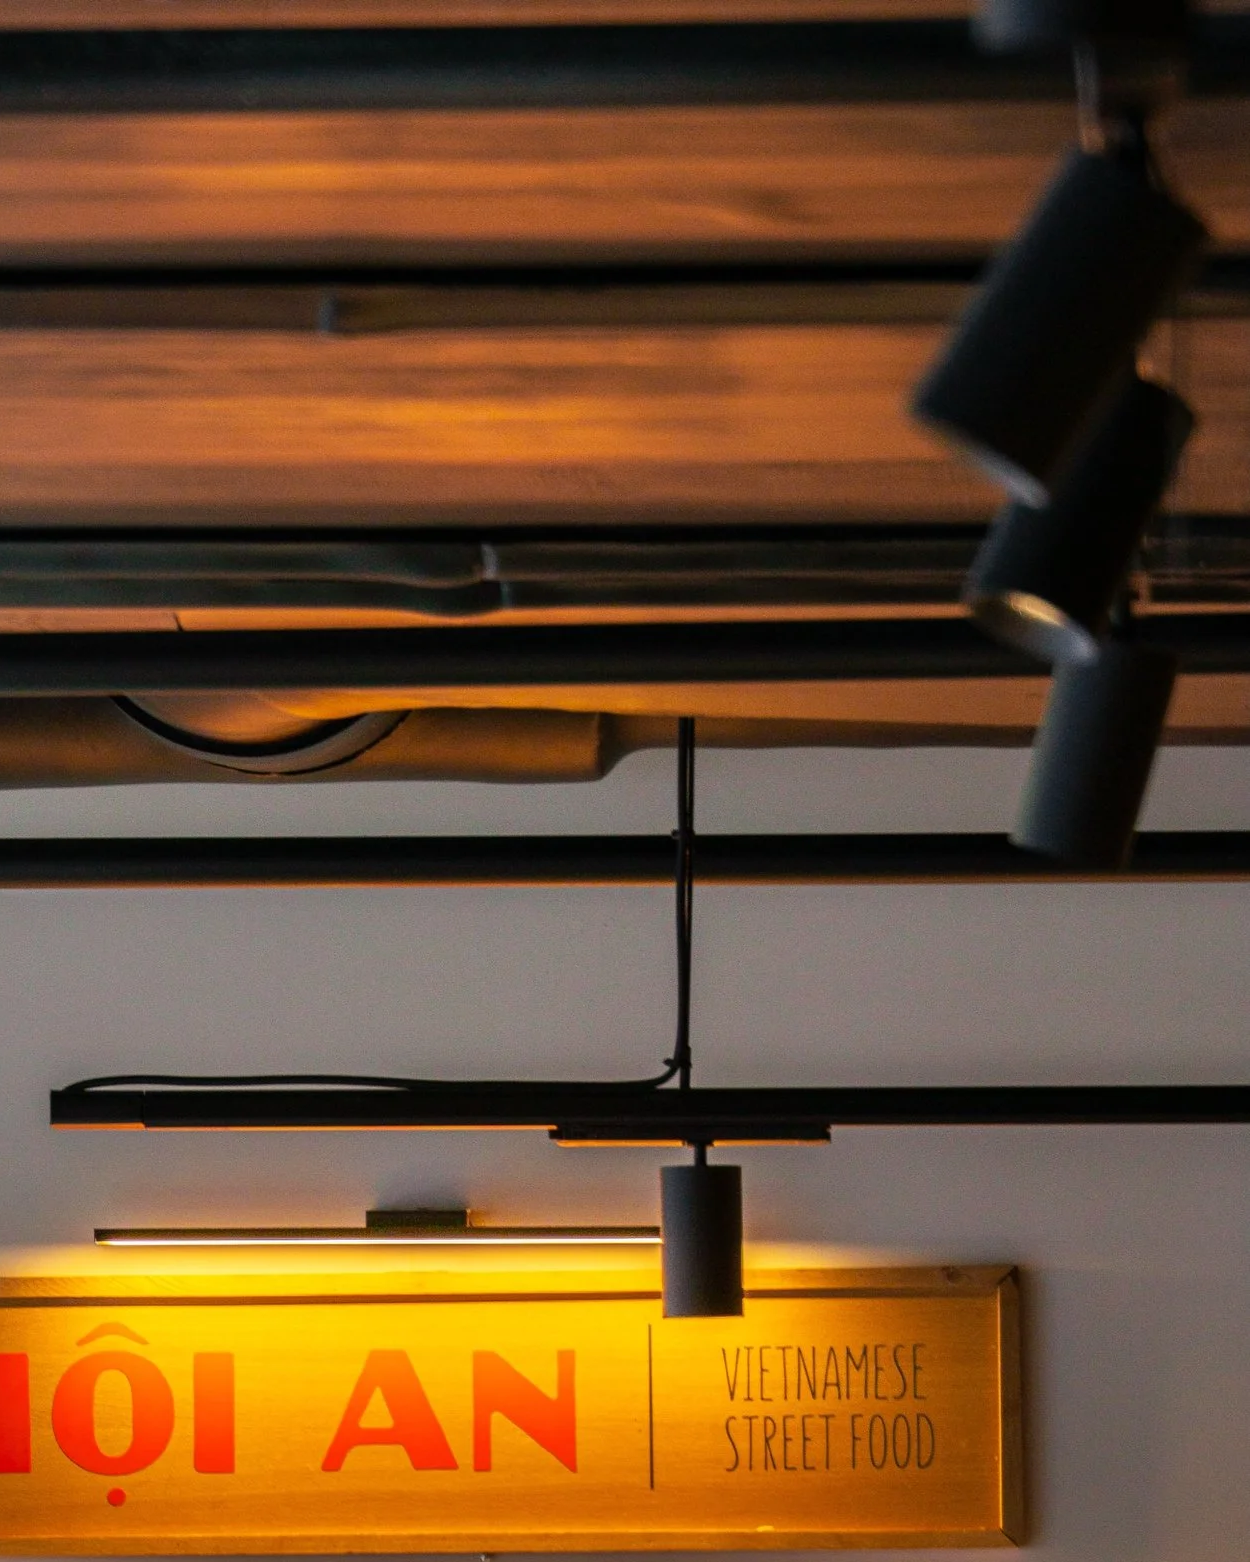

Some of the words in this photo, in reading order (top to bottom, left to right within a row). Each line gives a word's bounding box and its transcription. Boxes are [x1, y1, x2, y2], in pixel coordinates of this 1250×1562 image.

[721, 1344, 928, 1401] VIETNAMESE
[321, 1349, 578, 1474] AN
[725, 1413, 836, 1472] STREET
[851, 1412, 936, 1470] FOOD
